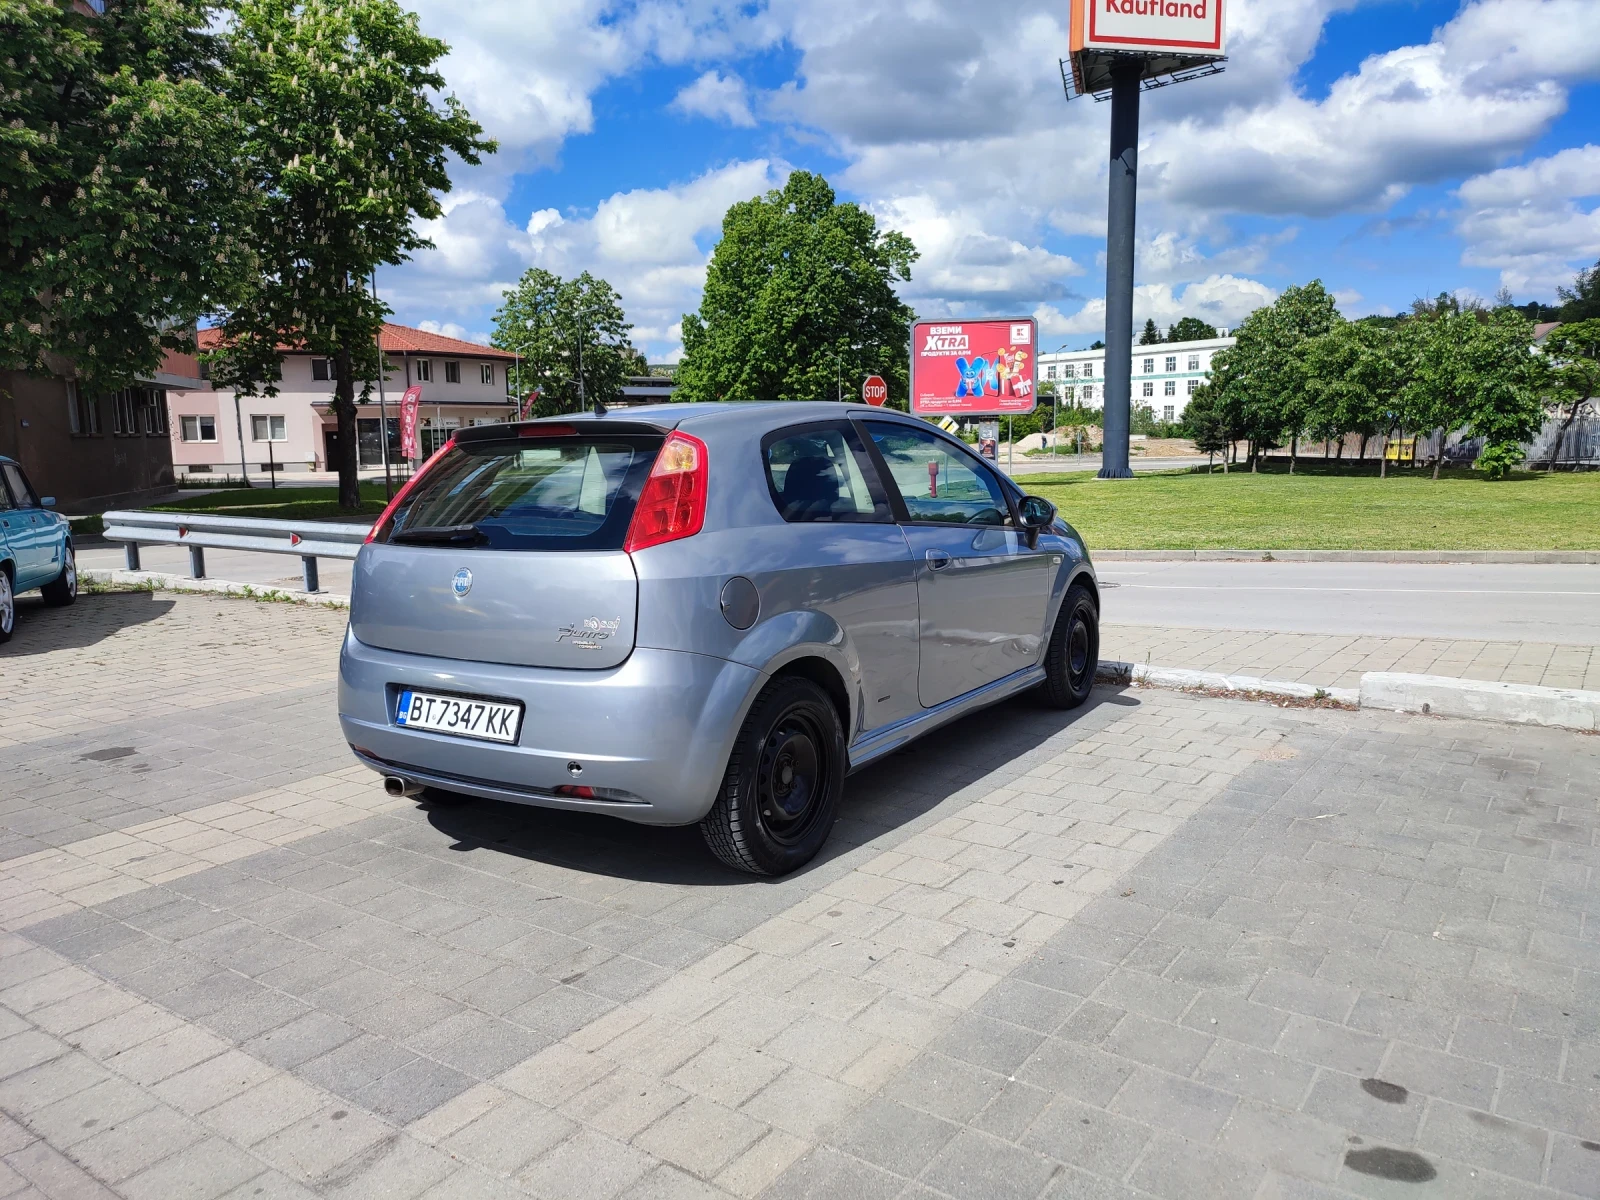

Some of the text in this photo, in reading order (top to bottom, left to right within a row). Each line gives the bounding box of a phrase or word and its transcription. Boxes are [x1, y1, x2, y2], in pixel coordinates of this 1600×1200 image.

[930, 326, 962, 335] ВЗЕМИ
[865, 385, 885, 398] STOP
[399, 711, 408, 719] BG
